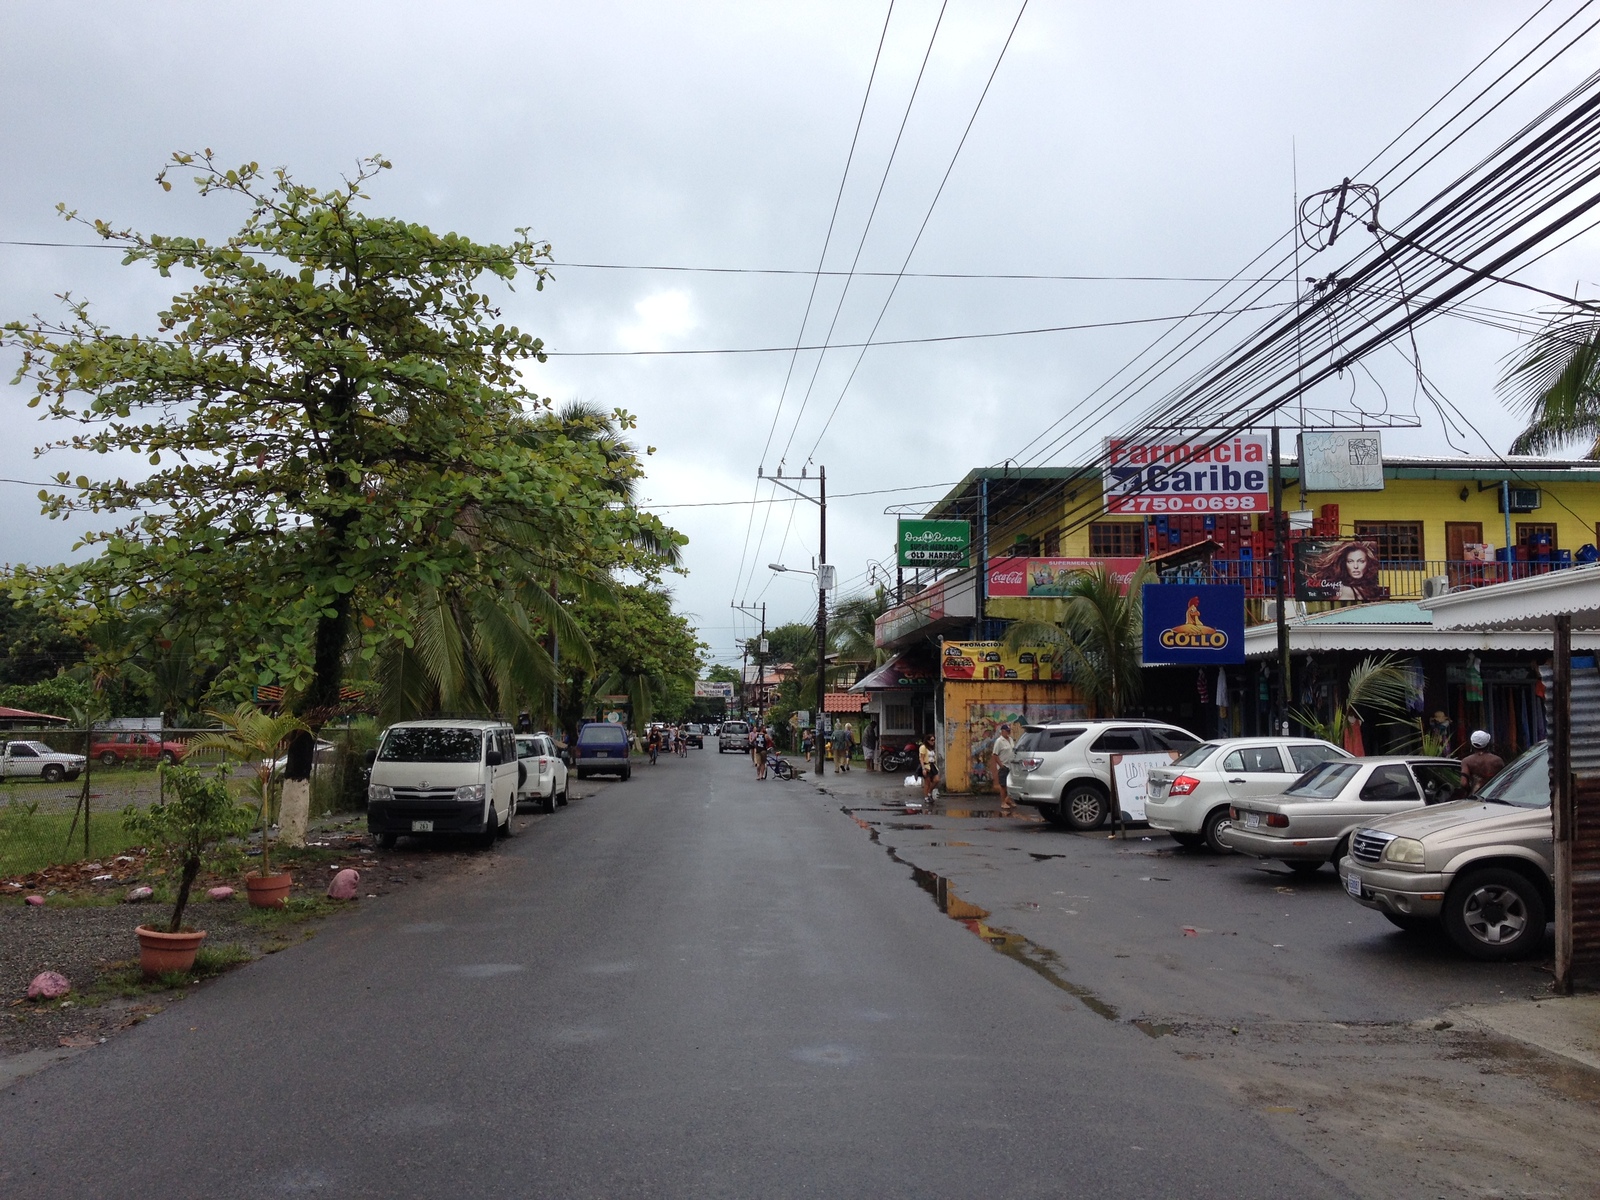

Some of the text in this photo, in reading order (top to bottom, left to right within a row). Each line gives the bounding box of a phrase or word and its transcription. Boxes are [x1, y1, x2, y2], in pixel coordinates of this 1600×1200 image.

[1110, 438, 1263, 464] Farmacia
[1147, 465, 1264, 492] Caribe
[1120, 496, 1256, 511] 2750-0698
[905, 531, 922, 541] Dos
[1162, 631, 1226, 647] GOLLO
